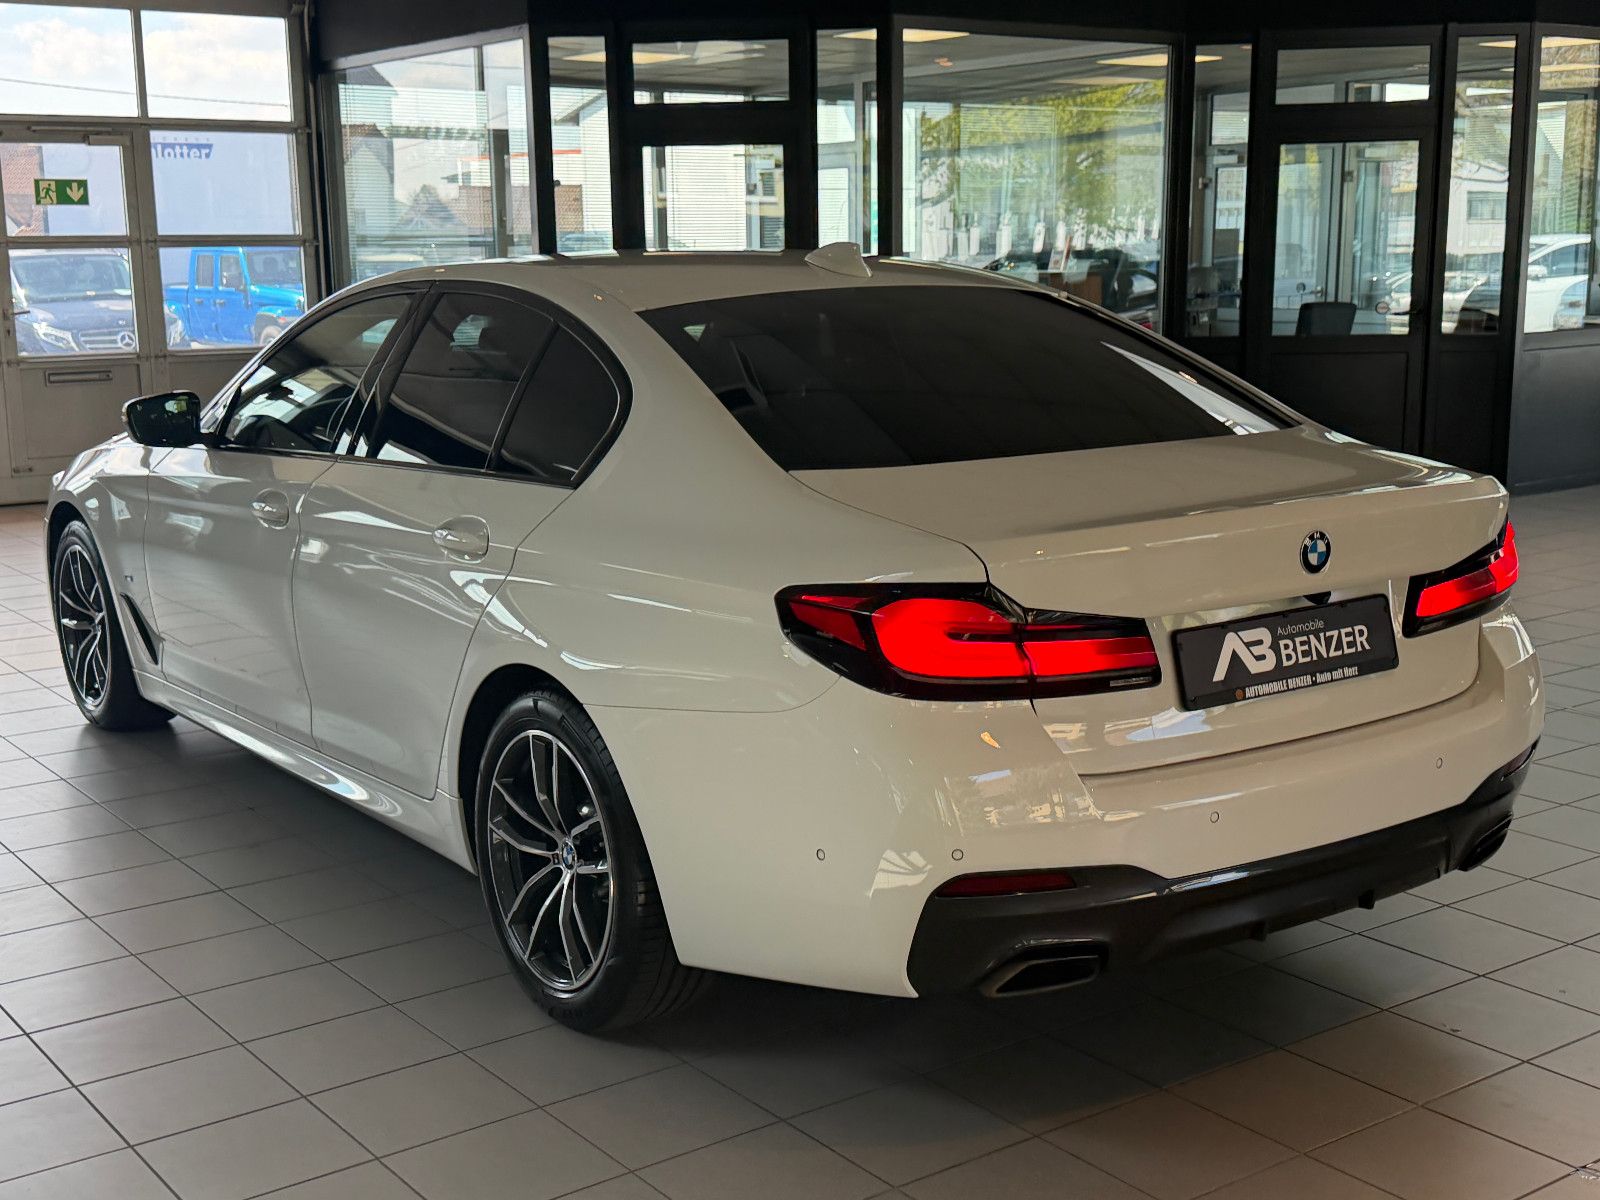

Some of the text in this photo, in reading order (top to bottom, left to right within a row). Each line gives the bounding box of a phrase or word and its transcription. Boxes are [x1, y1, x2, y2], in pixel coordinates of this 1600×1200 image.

[1277, 619, 1325, 636] Automobile
[1279, 624, 1371, 667] BENZER
[1245, 666, 1358, 699] AUTOMOBILE BENZER Auto mit Herz
